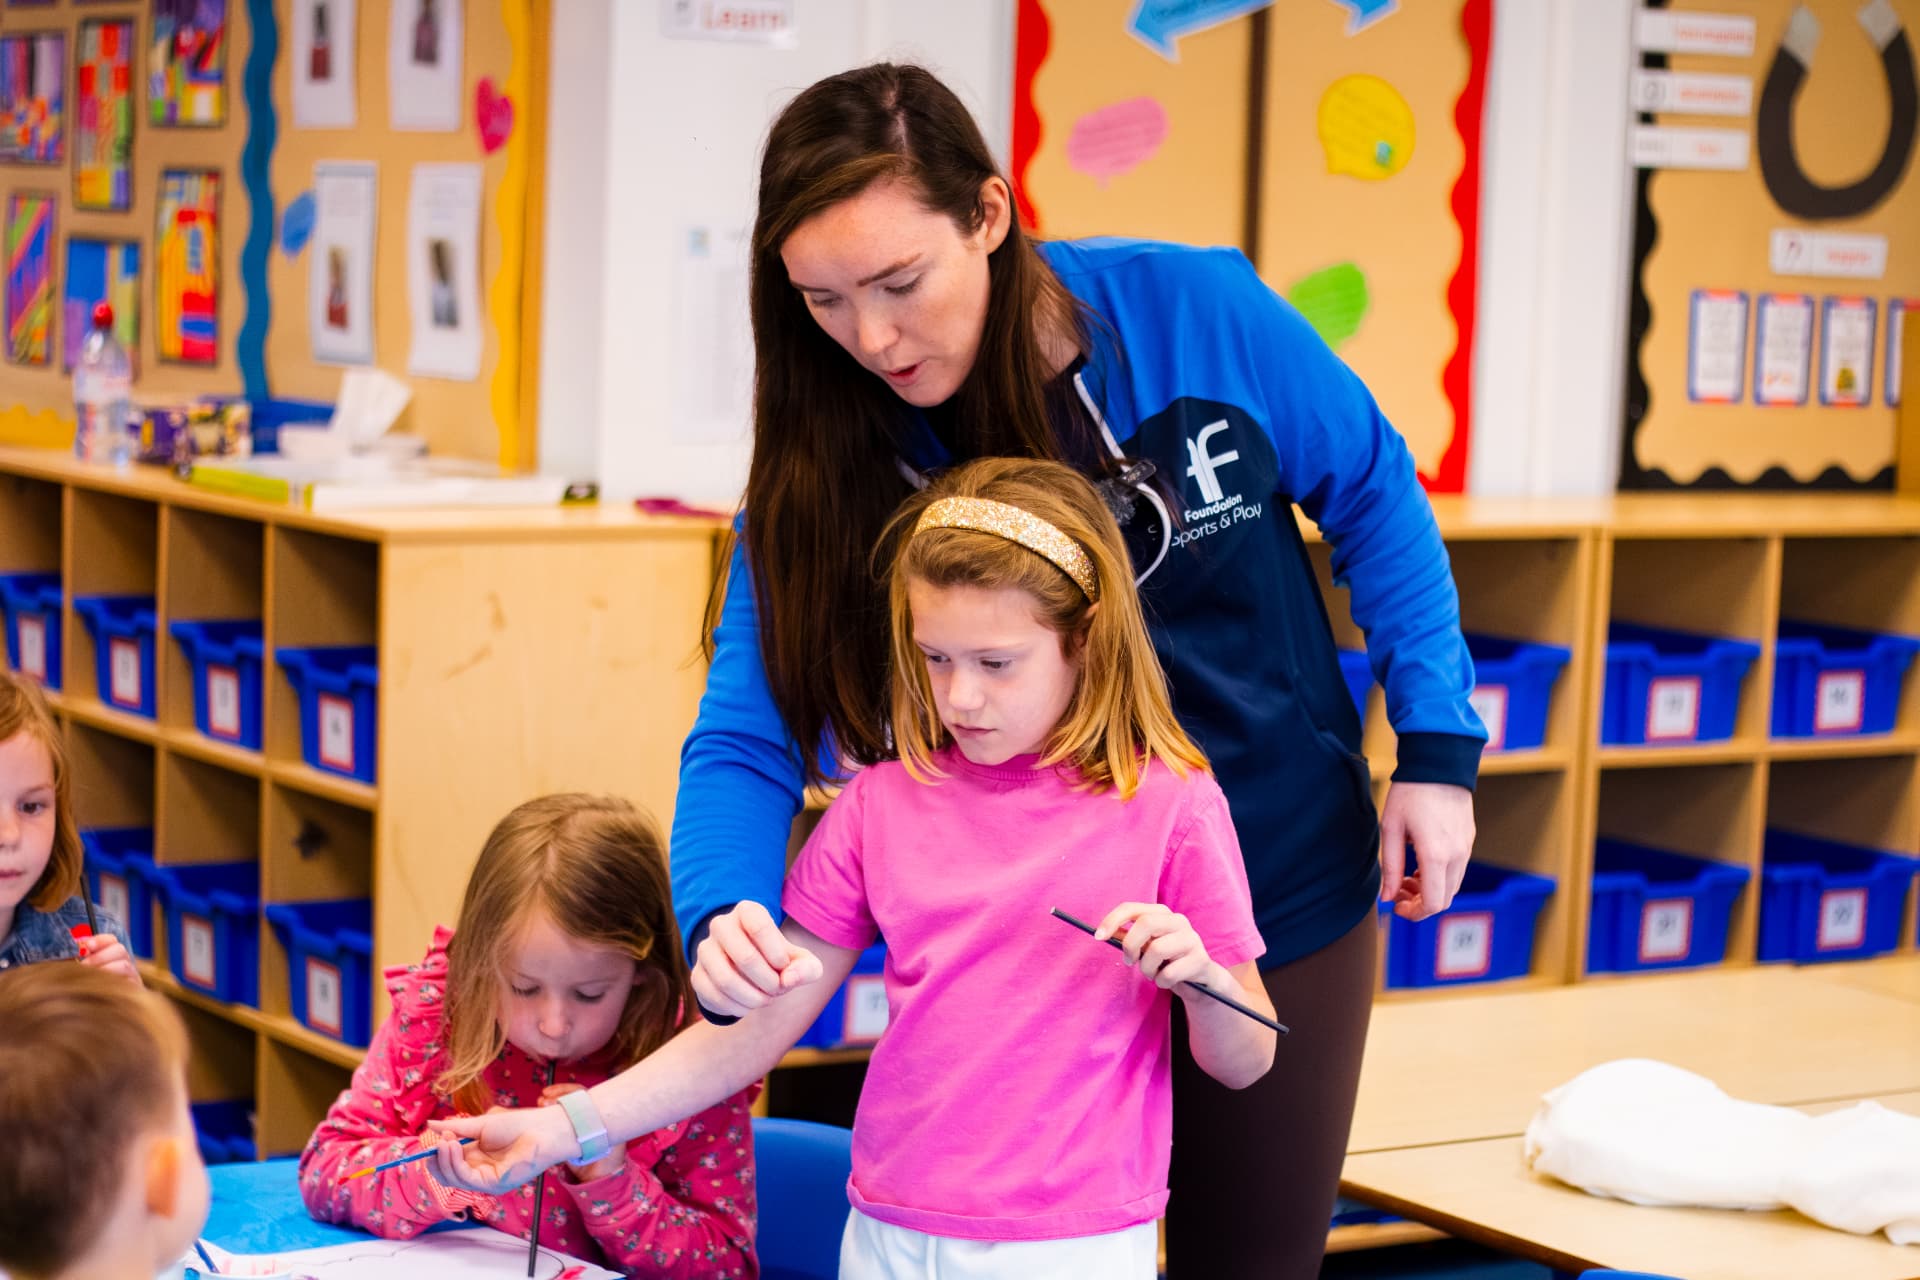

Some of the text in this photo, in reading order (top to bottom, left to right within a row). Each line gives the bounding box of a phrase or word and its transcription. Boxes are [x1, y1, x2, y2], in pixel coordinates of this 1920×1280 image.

[1184, 493, 1243, 523] Foundation
[1219, 513, 1231, 529] &
[1233, 503, 1262, 524] Play
